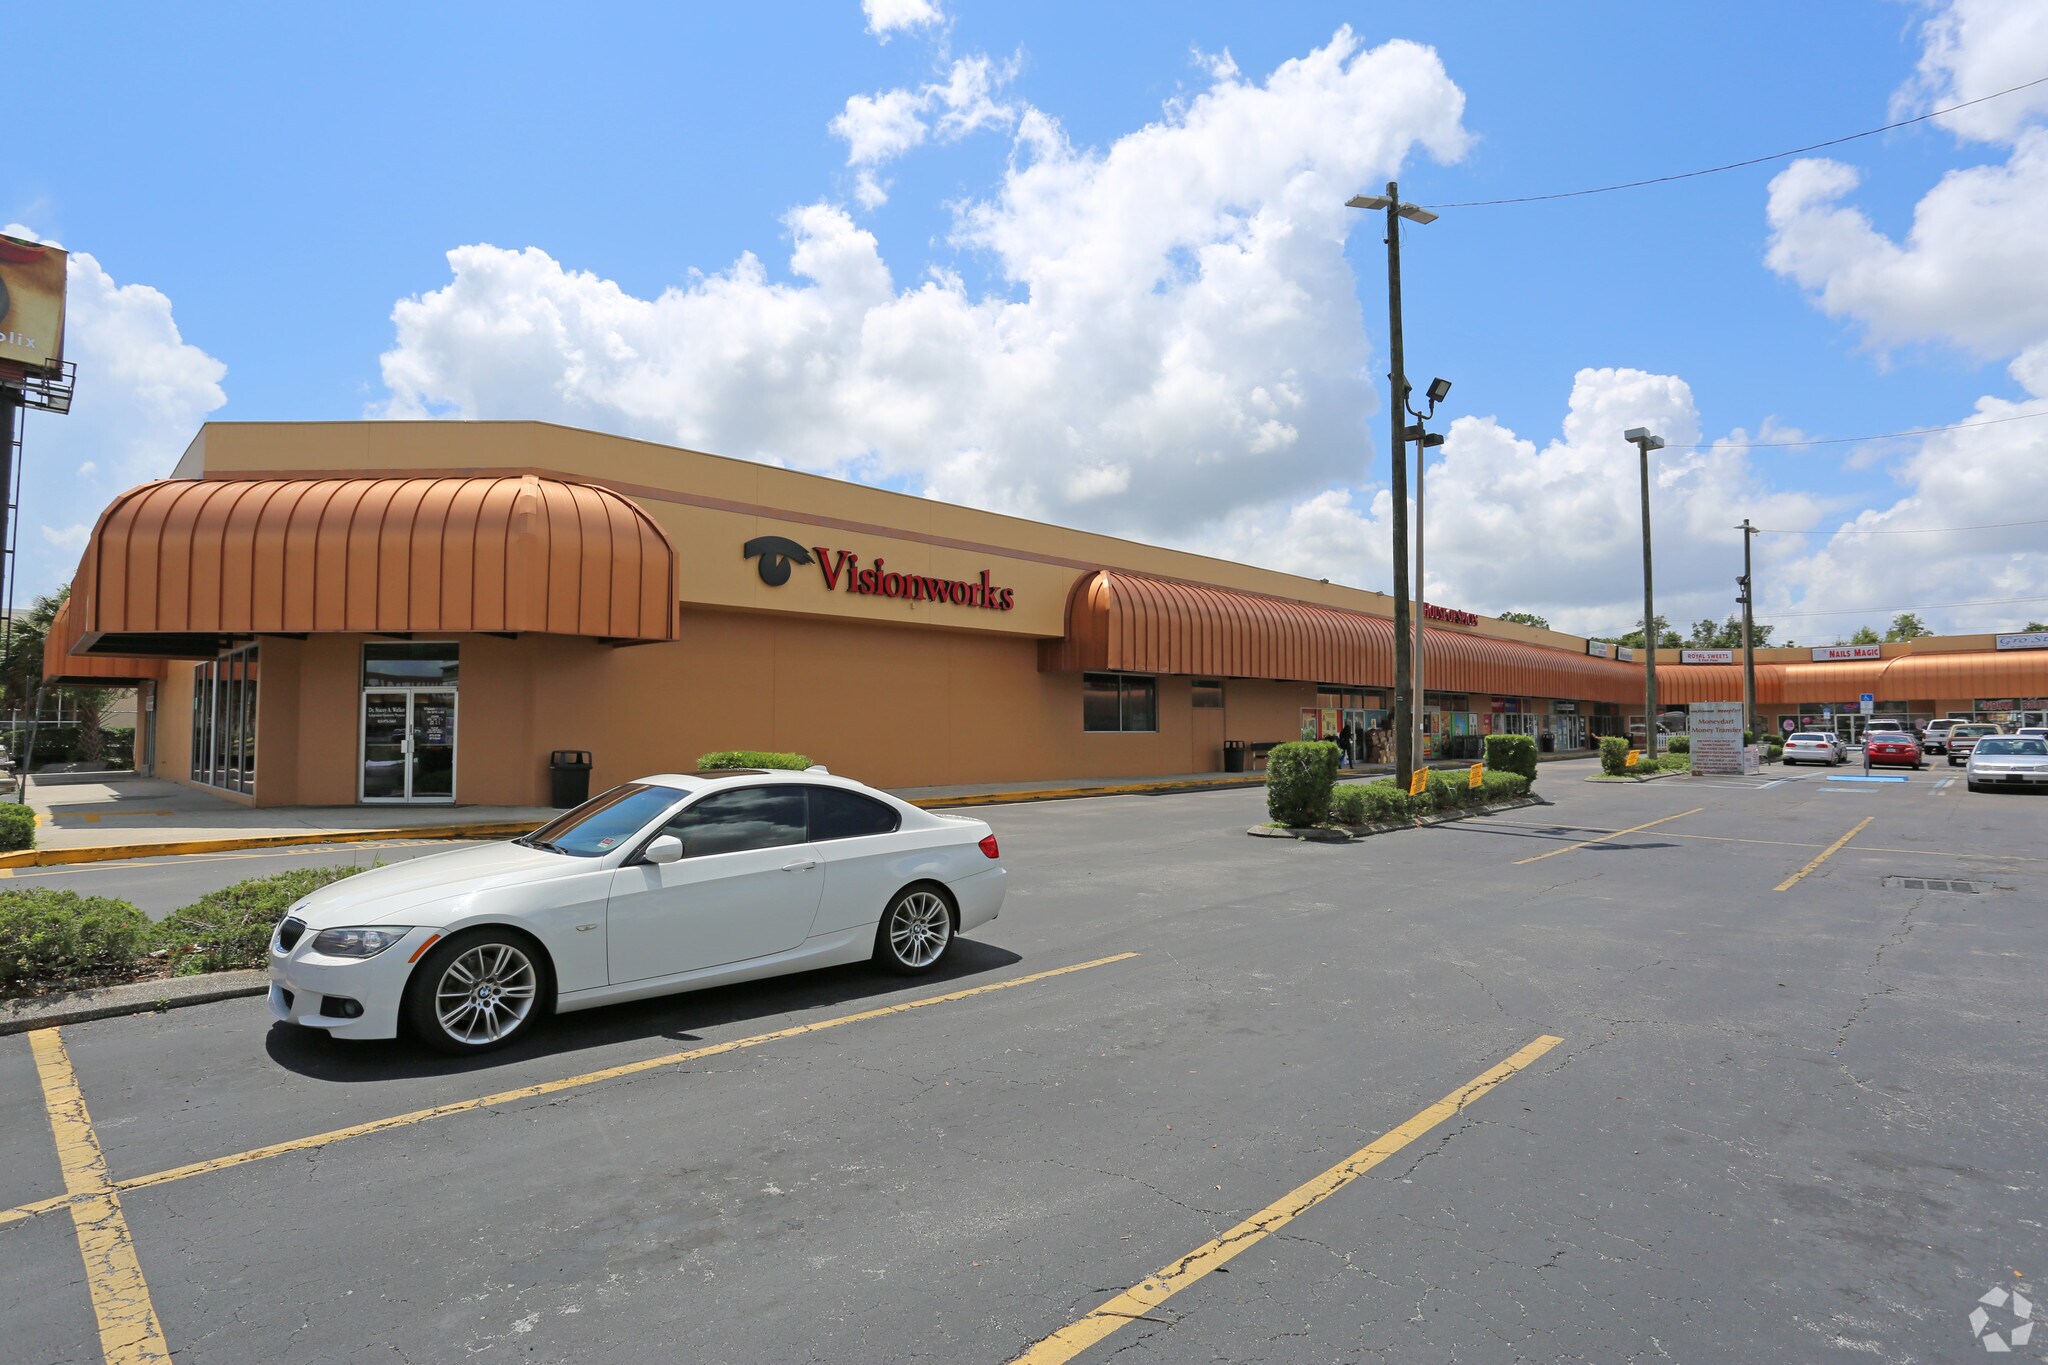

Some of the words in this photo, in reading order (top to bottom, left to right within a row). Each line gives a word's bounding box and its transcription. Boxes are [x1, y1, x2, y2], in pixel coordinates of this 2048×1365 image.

[812, 546, 1015, 611] Visionworks
[1829, 650, 1851, 658] NAILS
[1854, 648, 1879, 657] MAGIC
